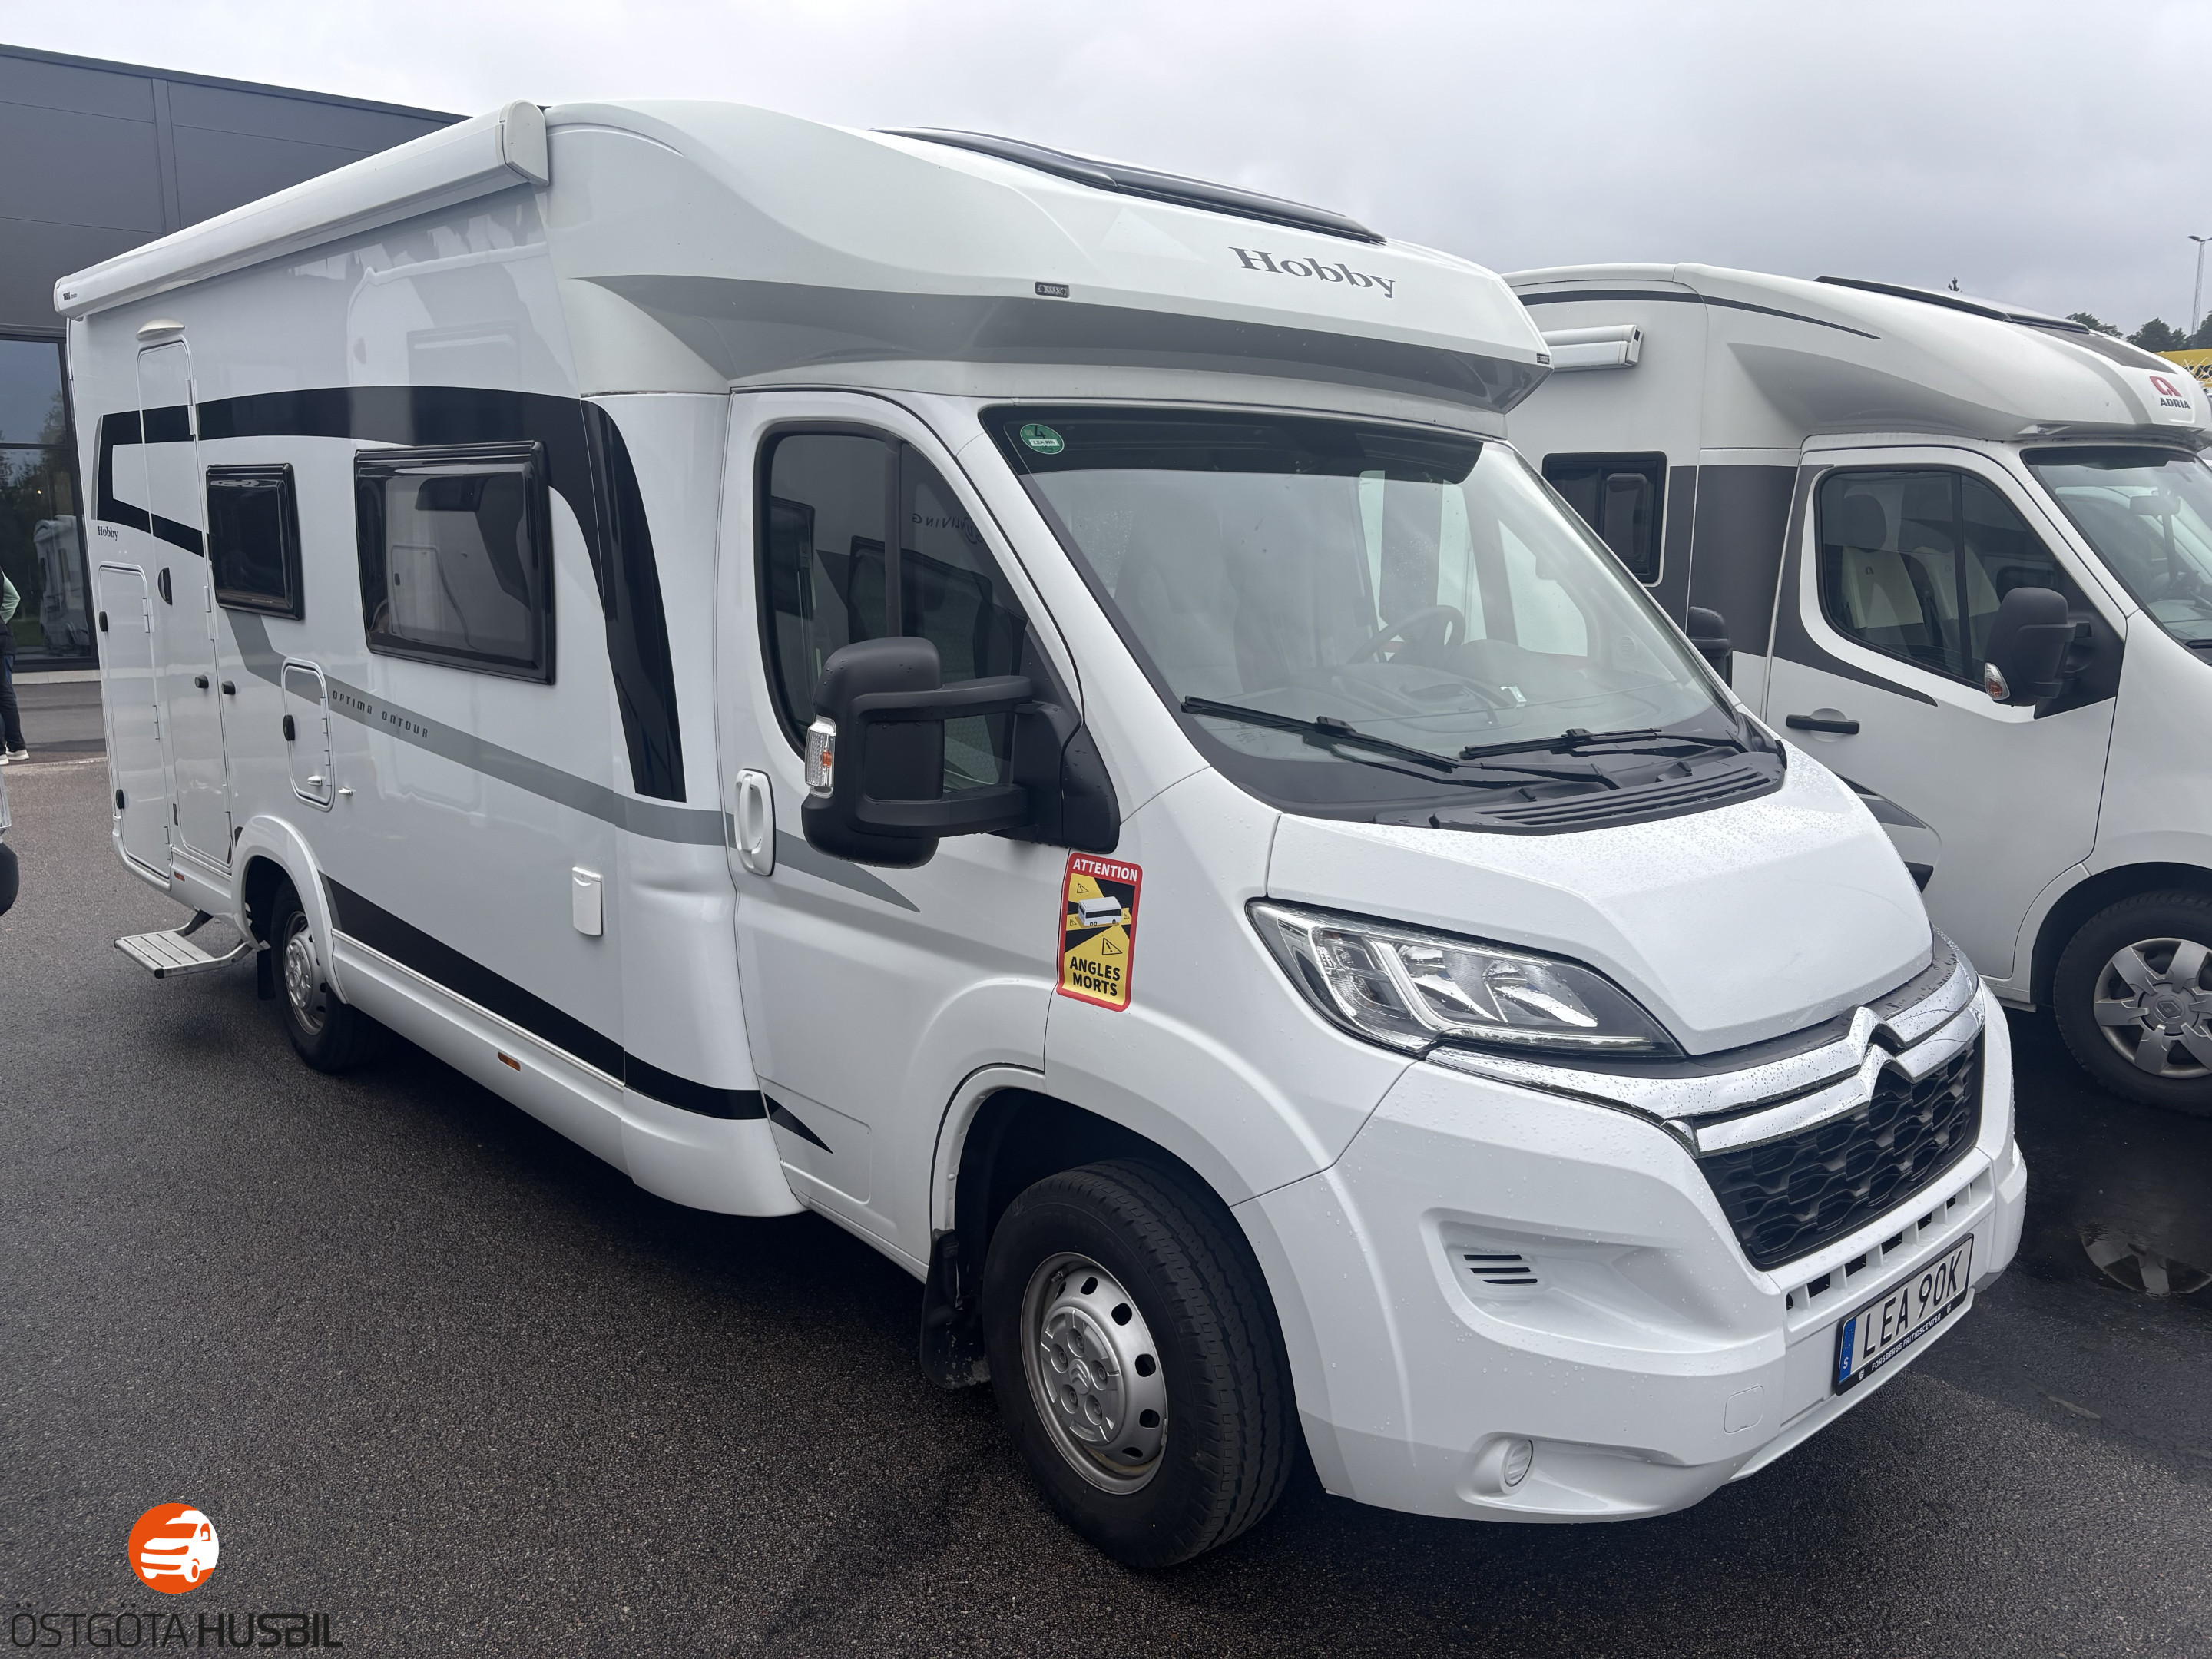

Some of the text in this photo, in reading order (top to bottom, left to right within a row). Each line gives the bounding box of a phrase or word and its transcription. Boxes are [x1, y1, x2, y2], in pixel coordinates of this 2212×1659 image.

[1227, 246, 1396, 299] Hobby
[2160, 398, 2191, 409] ADRIA
[1034, 426, 1046, 439] 4
[98, 525, 118, 541] Hobby
[333, 690, 428, 738] OPTIMA ONTOUR
[1072, 858, 1137, 882] ATTENTION
[1069, 956, 1121, 982] ANGLES
[1072, 972, 1118, 997] MORTS
[1863, 1249, 1962, 1359] LEA 90K
[1871, 1313, 1942, 1371] FORSBERGS FRITIDSCENTER
[1843, 1356, 1849, 1369] S
